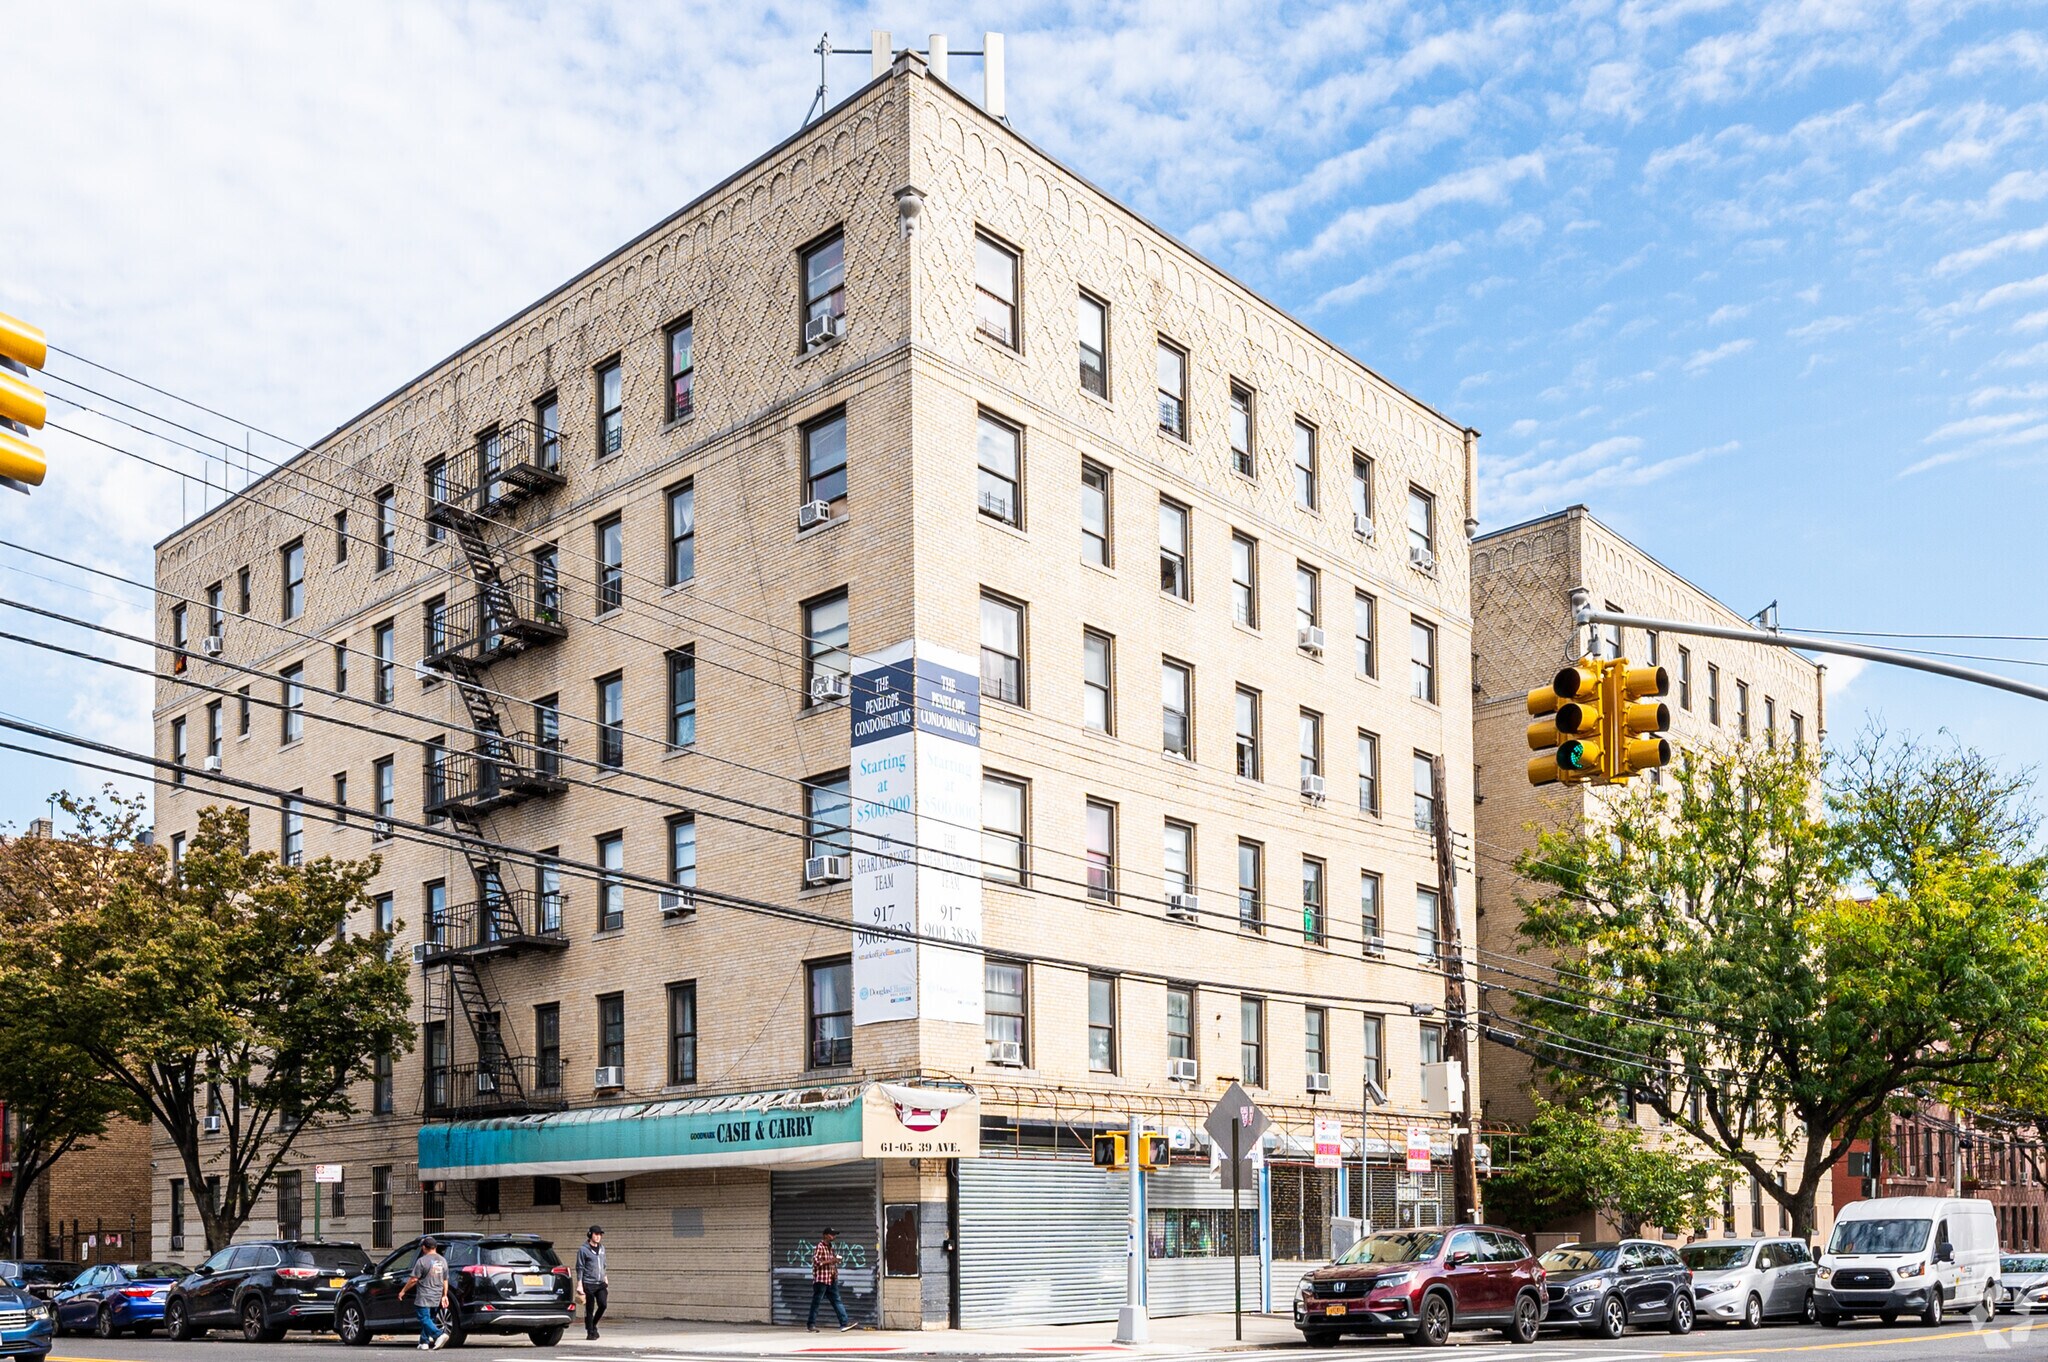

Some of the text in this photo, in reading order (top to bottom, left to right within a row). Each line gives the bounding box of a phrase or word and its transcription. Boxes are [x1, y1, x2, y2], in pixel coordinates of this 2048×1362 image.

[875, 676, 889, 692] THE
[941, 675, 956, 692] THE
[865, 692, 900, 715] PENELOPE
[931, 692, 966, 715] PENELOPE
[855, 708, 911, 737] CONDOMINIUMS
[920, 710, 977, 738] CONDOMINIUMS
[860, 753, 906, 777] Starting
[877, 780, 888, 793] at
[857, 795, 911, 823] $500,000
[877, 833, 891, 850] THE
[857, 856, 878, 875] SHARI
[875, 873, 894, 891] TEAM
[873, 904, 895, 924] 917
[690, 1116, 815, 1143] GOODMARK CASH & CARRY
[880, 1142, 961, 1152] 61-05 39 AVE.
